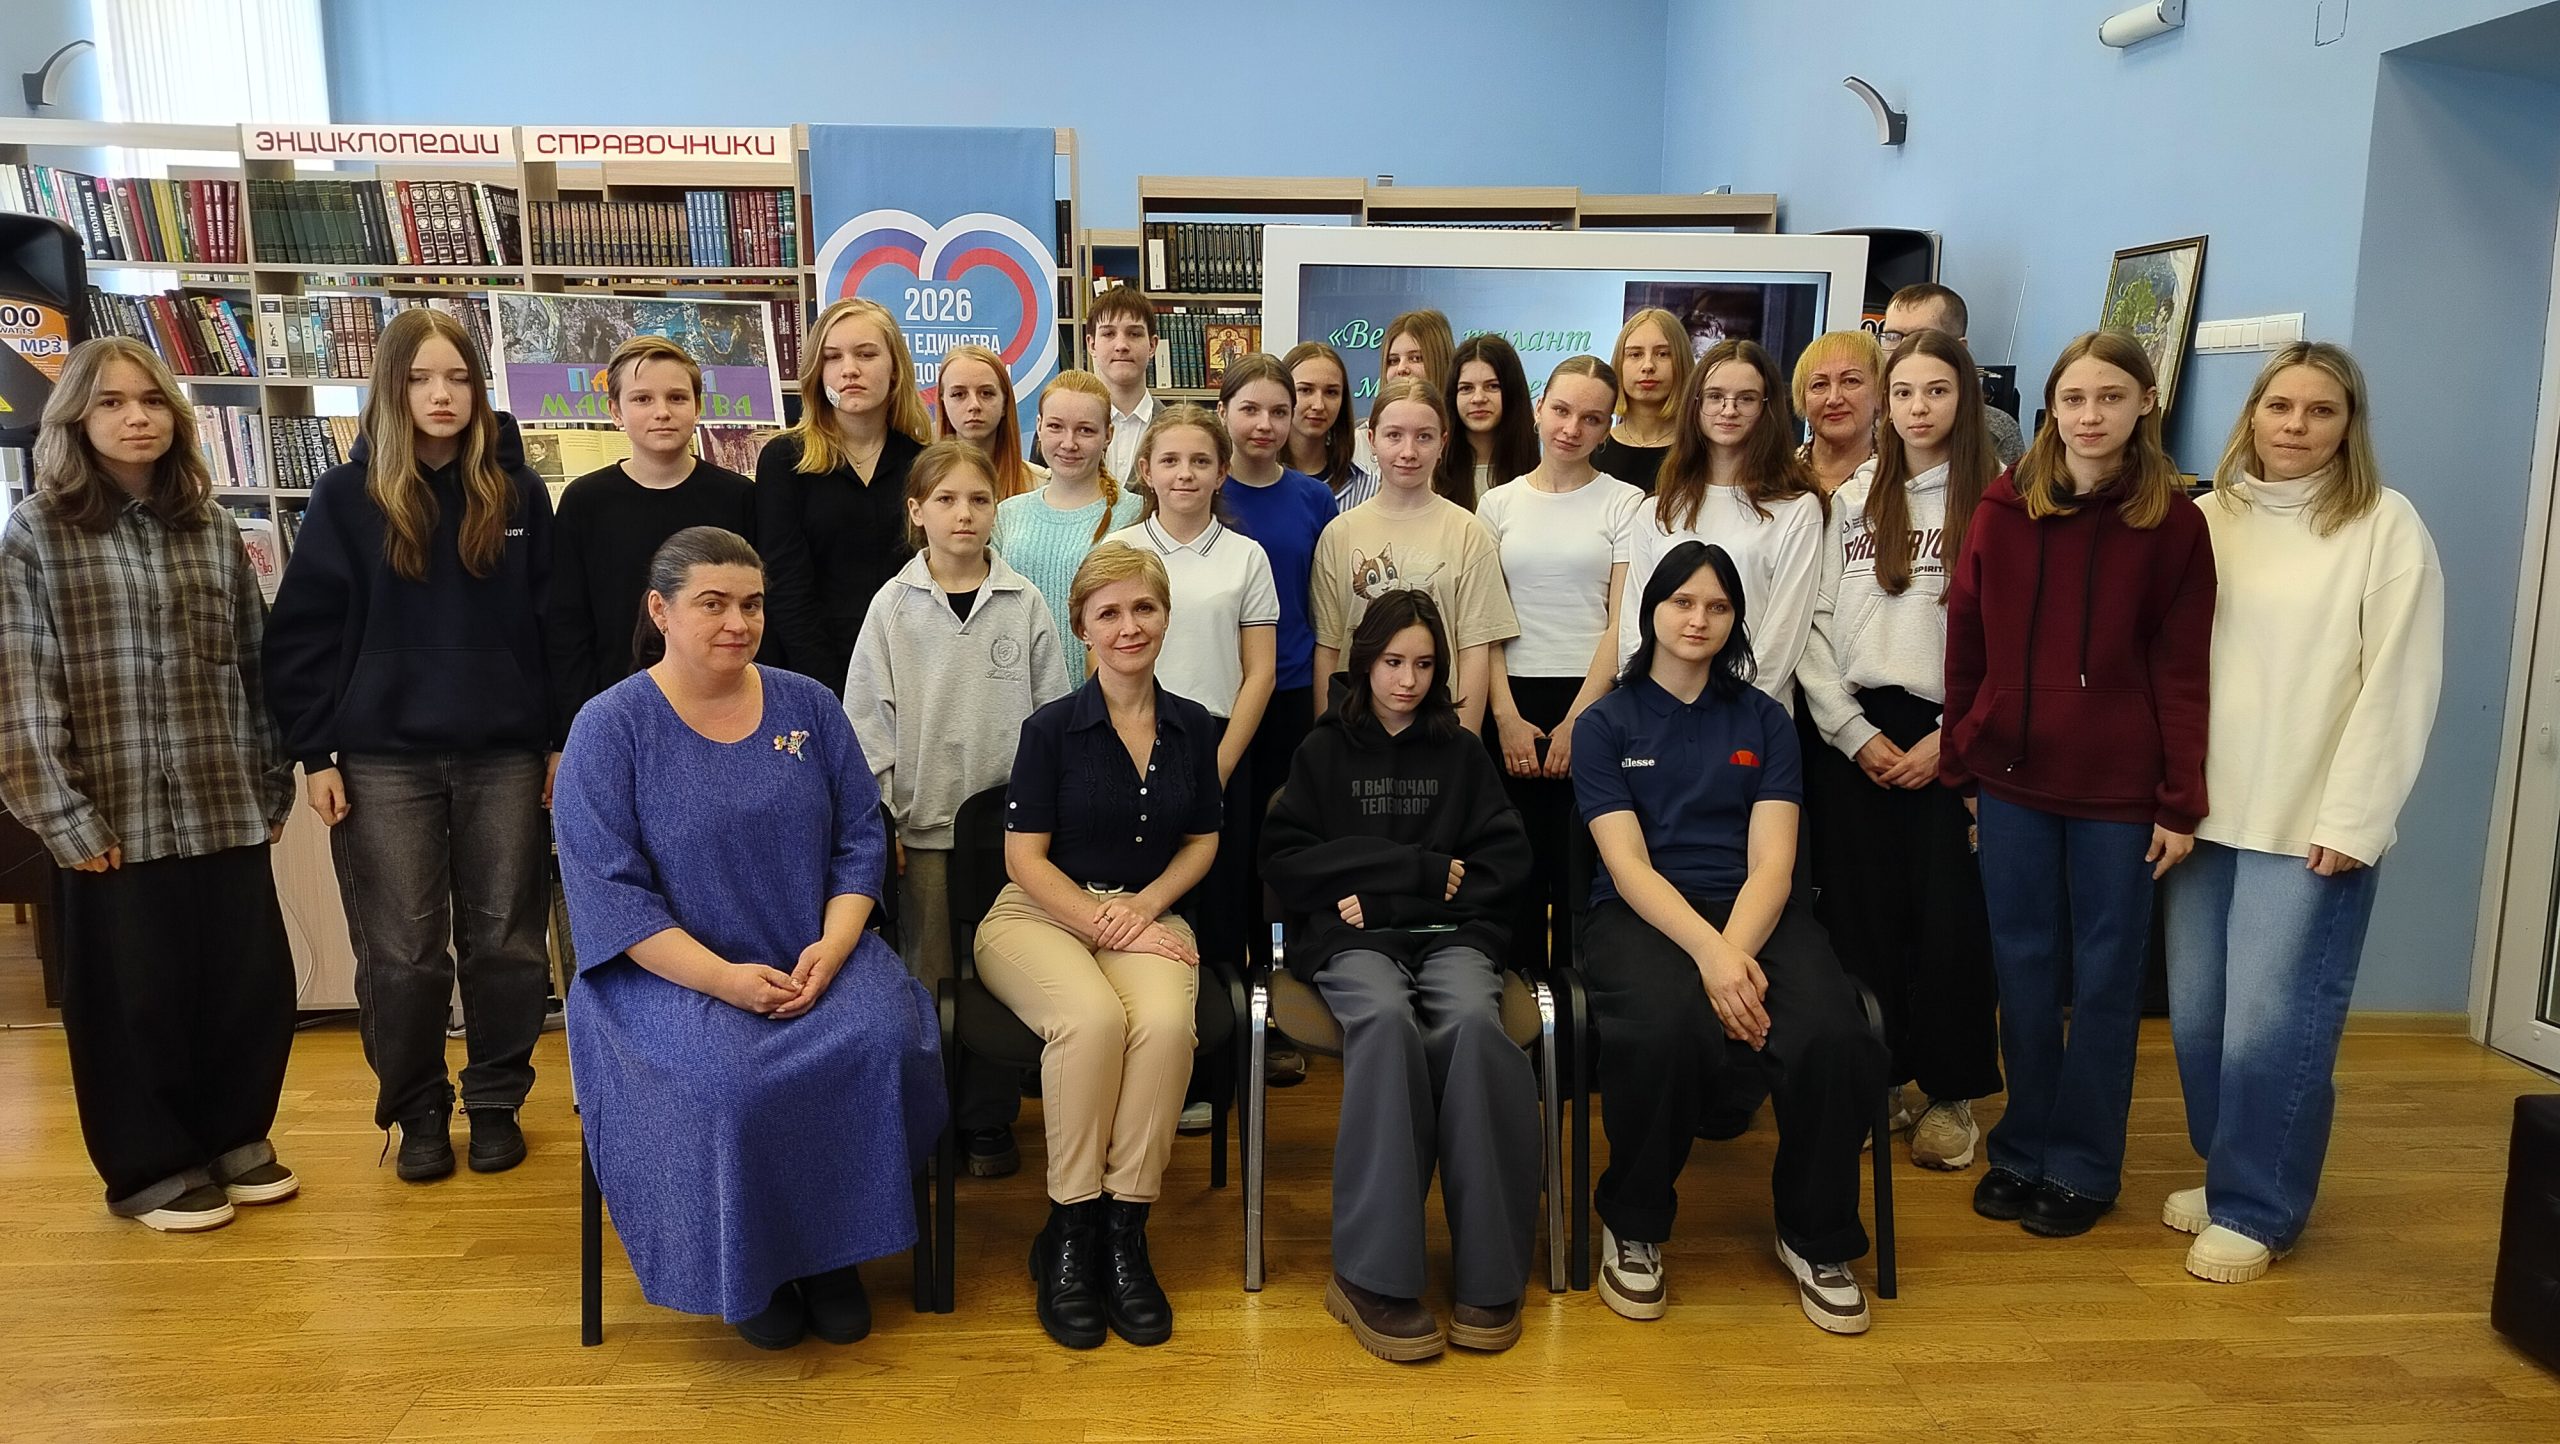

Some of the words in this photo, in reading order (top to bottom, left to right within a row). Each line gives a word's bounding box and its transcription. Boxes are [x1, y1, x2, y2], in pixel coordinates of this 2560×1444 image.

[255, 131, 500, 154] ЭНЦИКЛОПЕДИИ
[536, 133, 776, 155] СПРАВОЧНИКИ
[85, 191, 103, 242] БИОЛОГИЯ
[904, 287, 972, 322] 2026
[20, 339, 62, 353] MP3
[915, 333, 1001, 356] ЕДИНСТВА
[1914, 565, 1943, 574] SPIRIT
[1621, 758, 1655, 768] ellesse
[1351, 780, 1360, 797] Я
[1364, 777, 1439, 796] ВЫКЮЧАЮ
[1360, 797, 1430, 815] ТЕЛЕИЗОР
